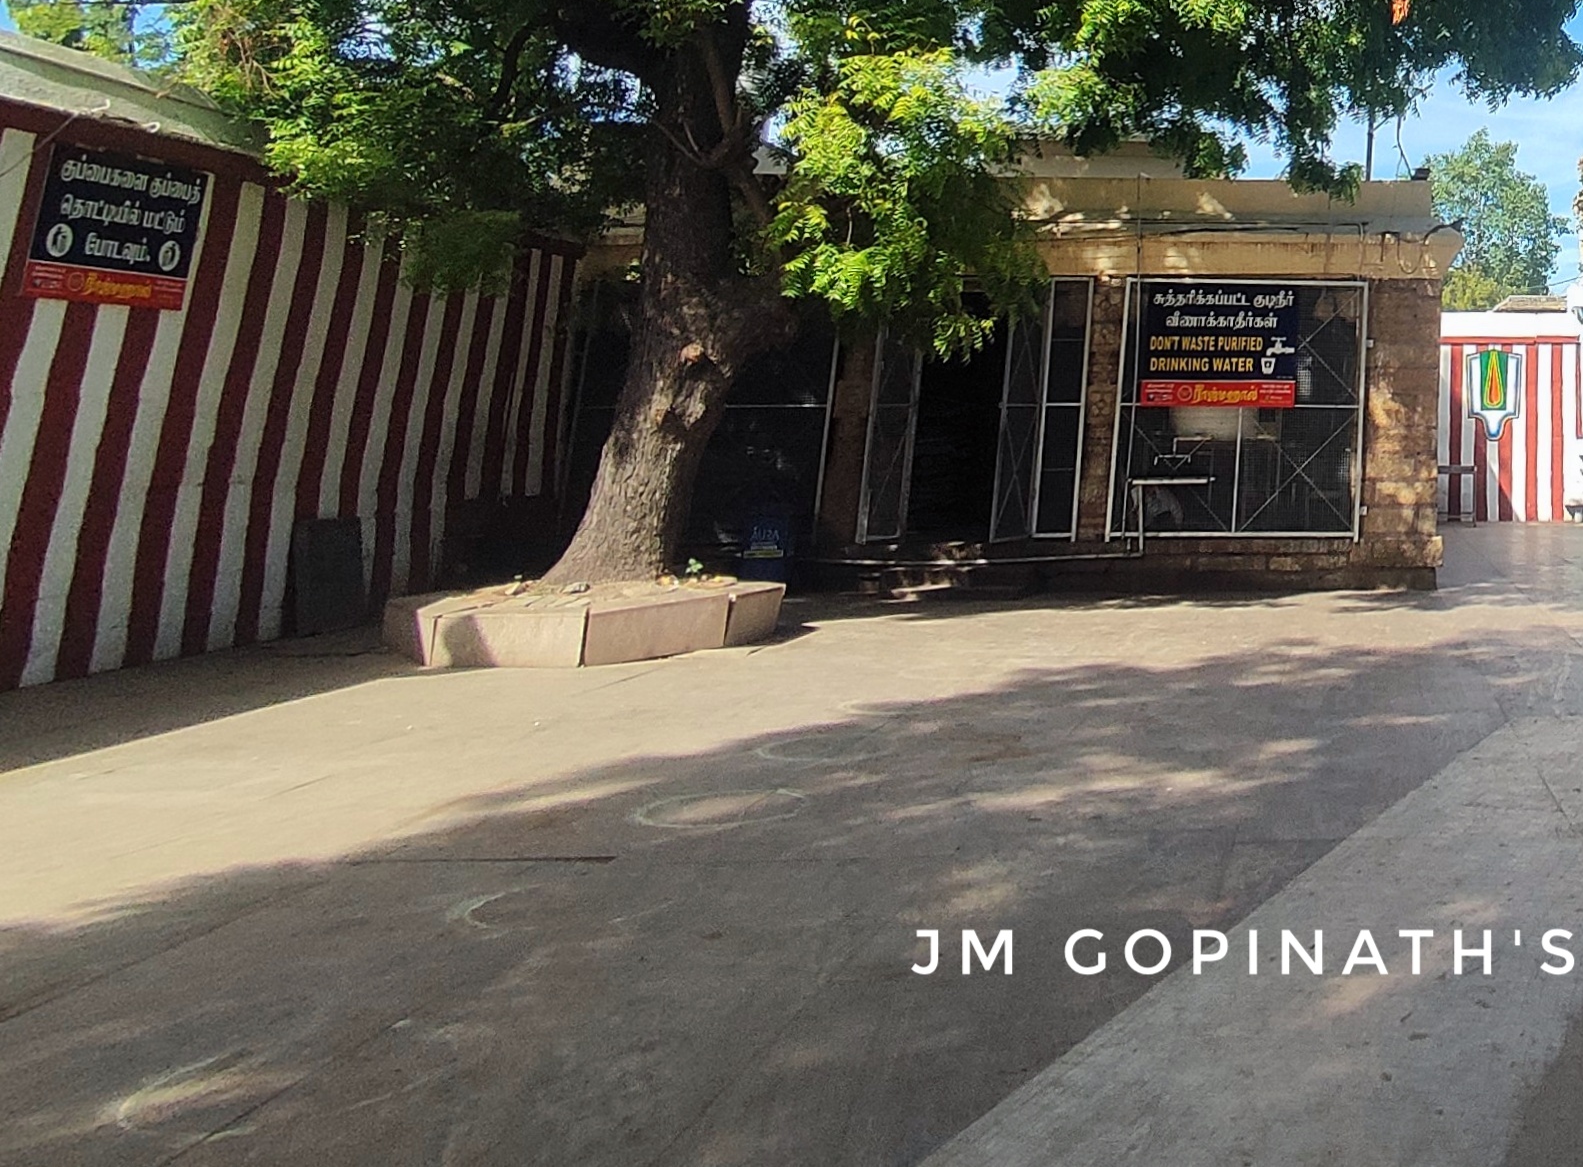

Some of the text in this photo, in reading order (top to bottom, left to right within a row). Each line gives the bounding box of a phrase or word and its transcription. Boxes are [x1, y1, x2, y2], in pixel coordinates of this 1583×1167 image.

[143, 209, 186, 235] மட்டும்
[1253, 290, 1295, 309] குடிநீர்
[1165, 310, 1279, 330] வீணாக்காதீர்கள்
[1149, 336, 1264, 352] DON'T WASTE PURIFIED
[1149, 357, 1254, 372] DRINKING WATER
